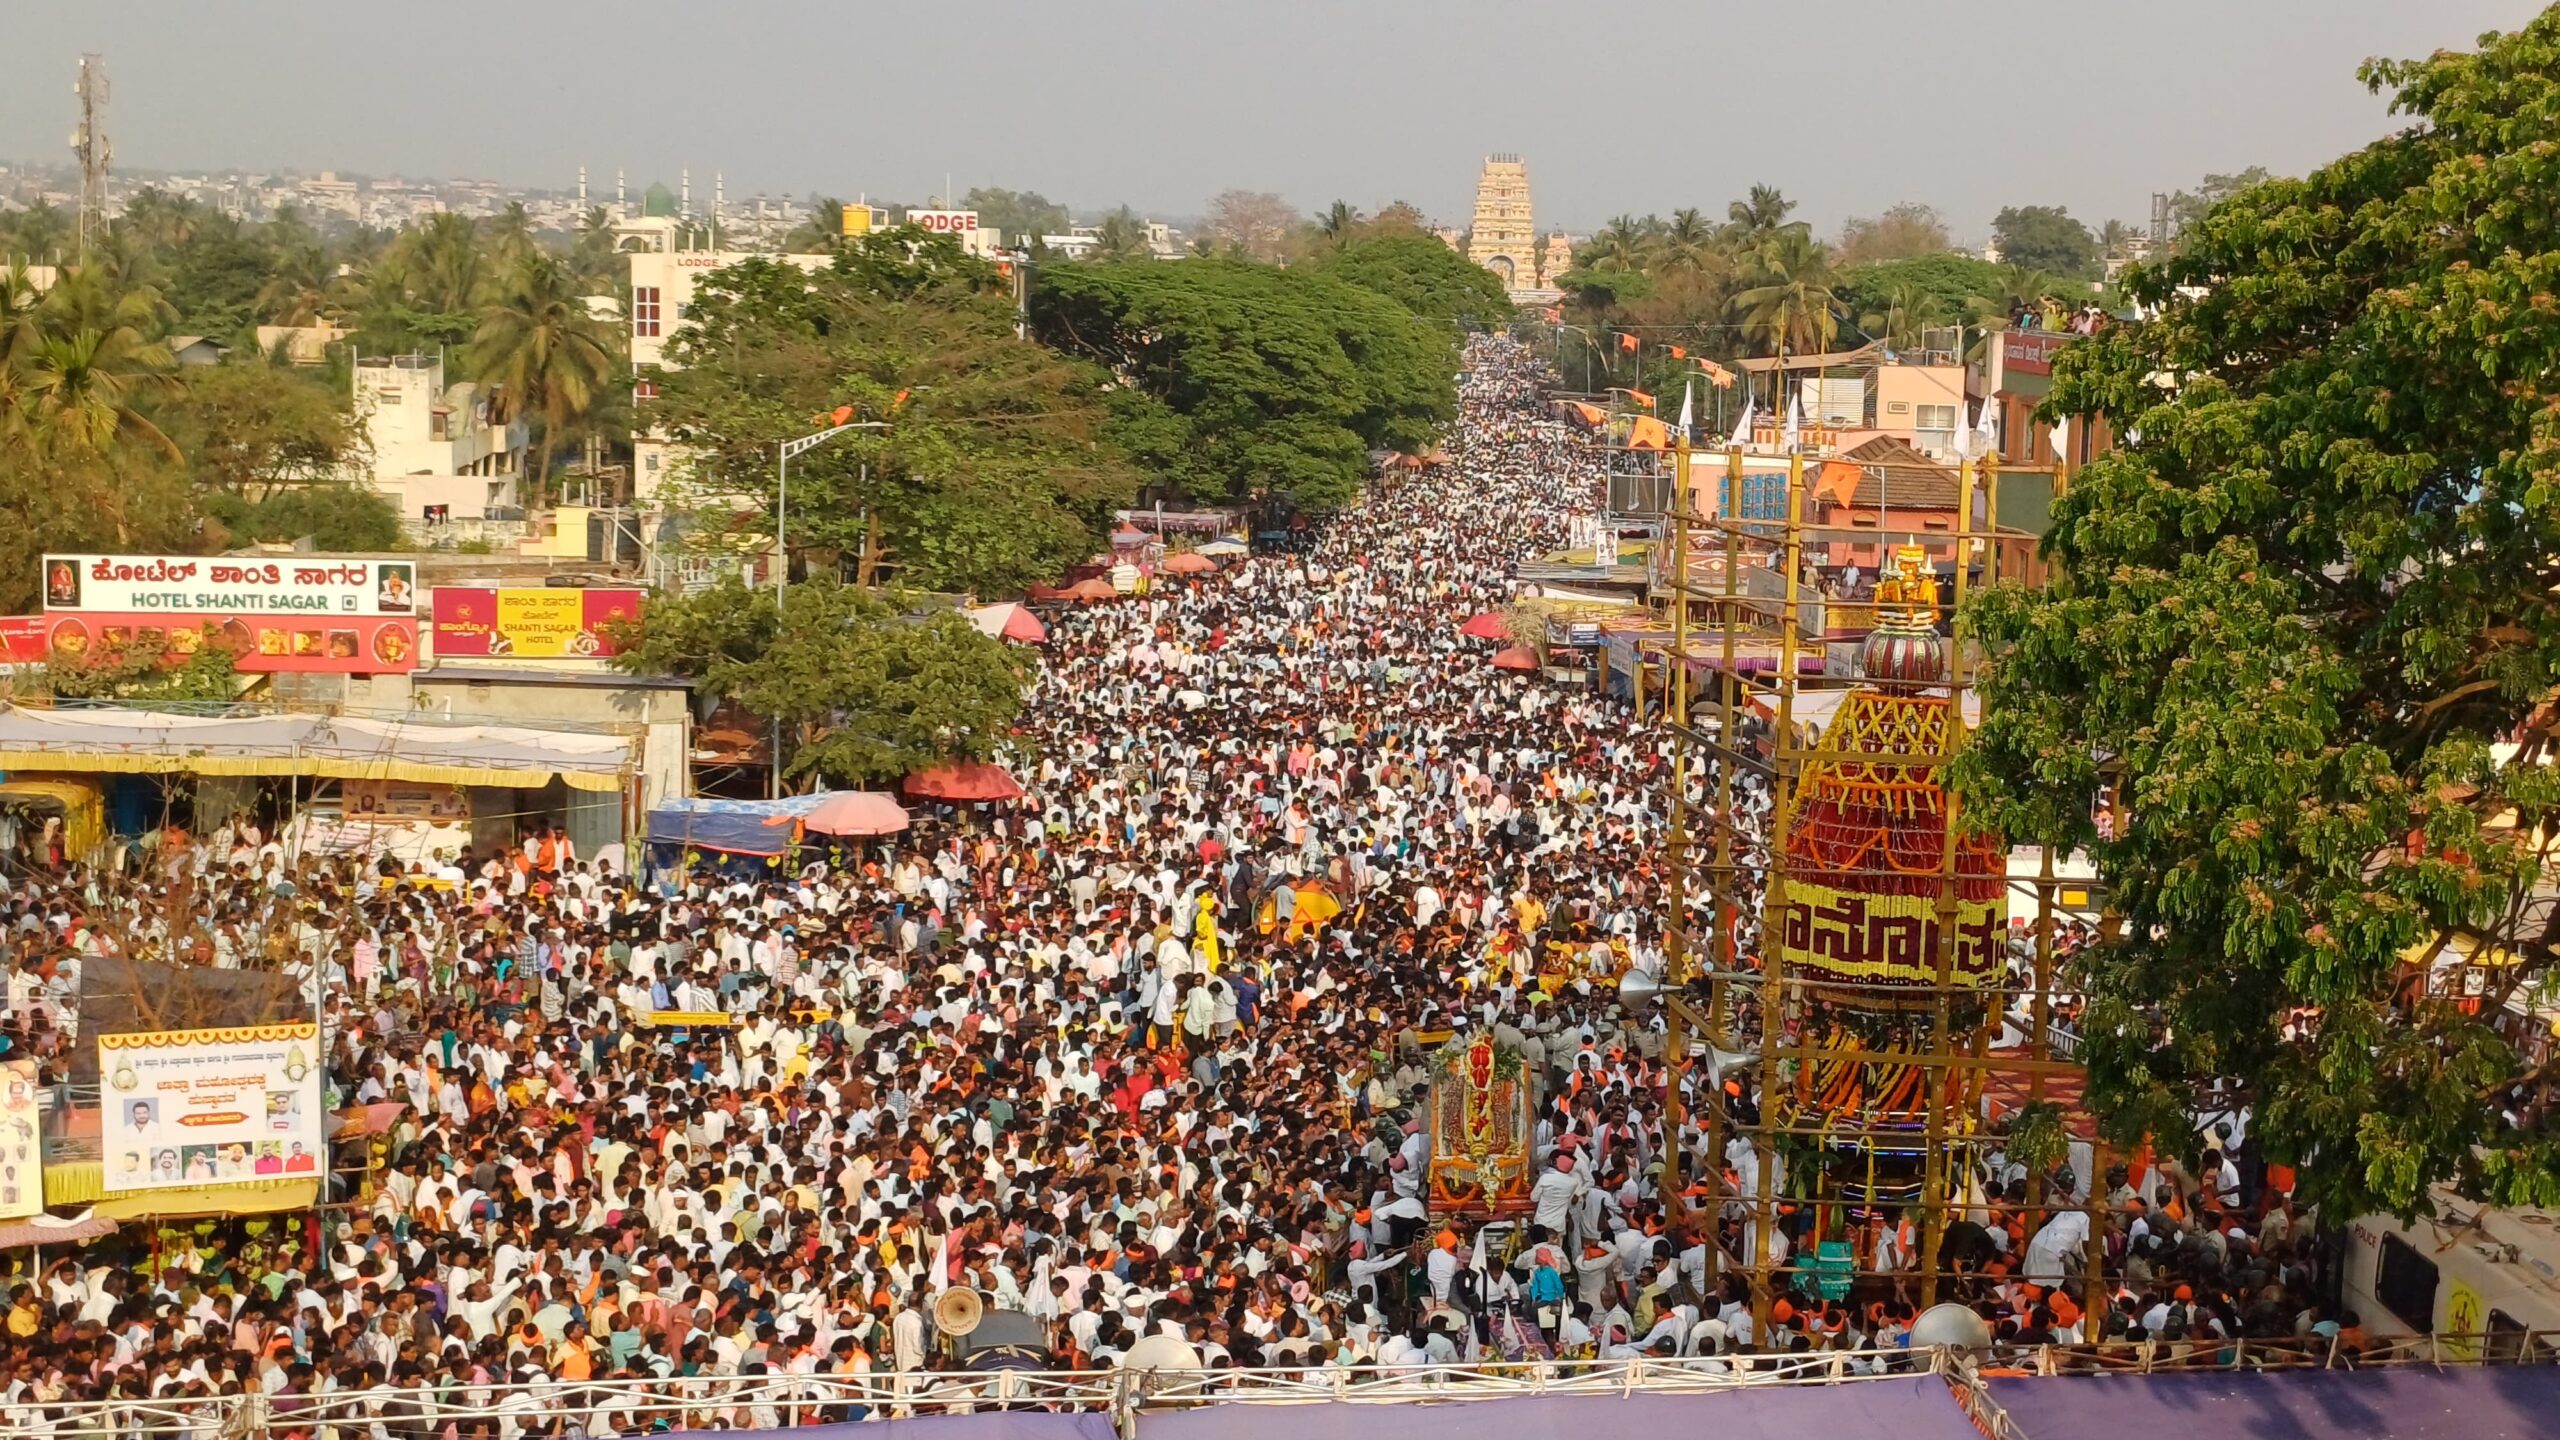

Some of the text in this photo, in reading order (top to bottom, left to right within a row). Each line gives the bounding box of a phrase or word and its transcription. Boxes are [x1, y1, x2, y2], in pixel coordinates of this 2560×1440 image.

[677, 259, 719, 267] LODGE
[91, 558, 368, 587] ಹೋಟೆಲ್ ಶಾಂತಿ ಸಾಗರ
[131, 592, 328, 610] HOTEL SHANTI SAGAR
[503, 623, 577, 634] SHANTI SAGAR
[526, 635, 555, 644] HOTEL
[2354, 1223, 2377, 1248] POLICE
